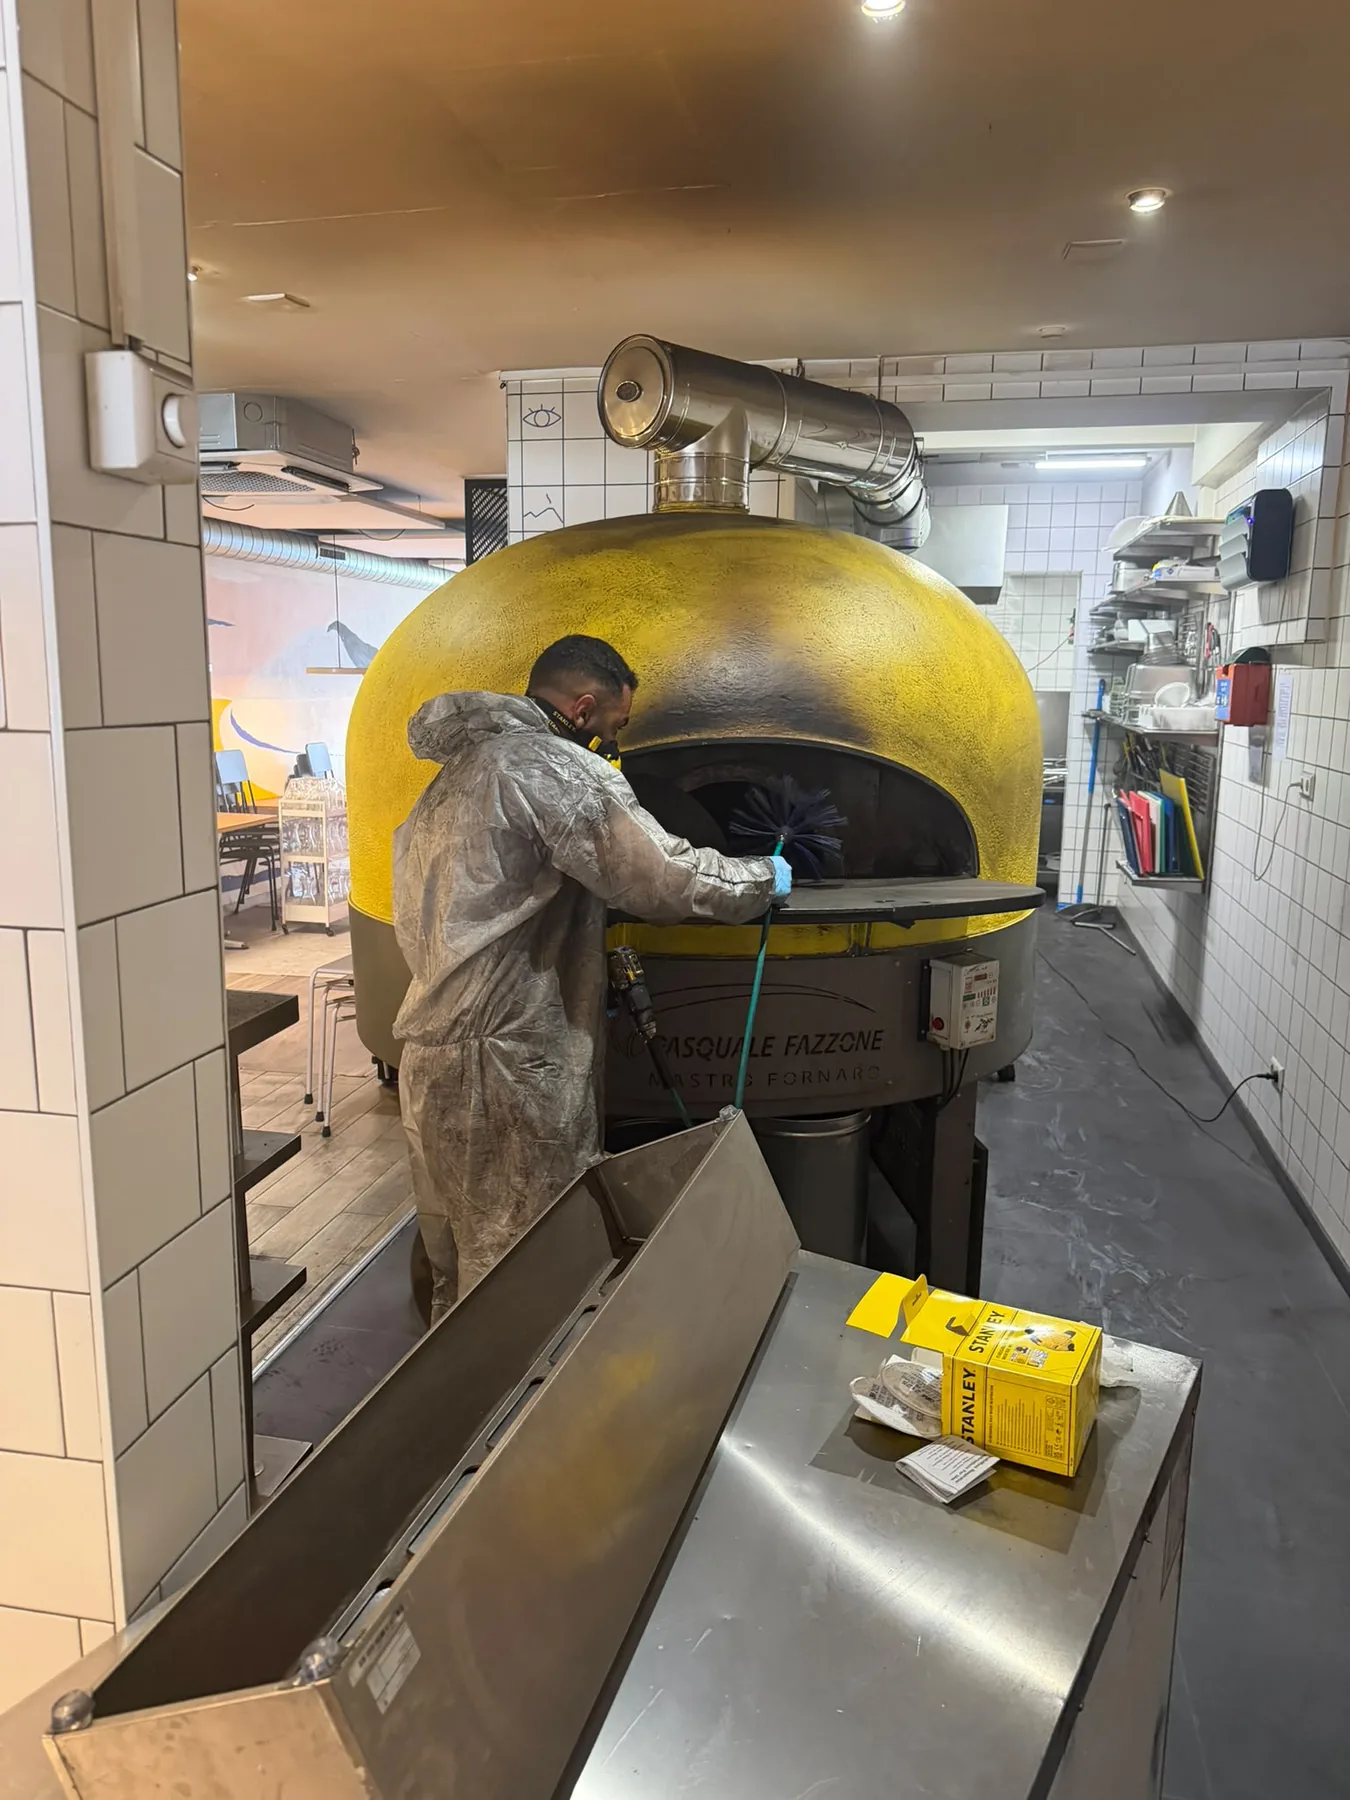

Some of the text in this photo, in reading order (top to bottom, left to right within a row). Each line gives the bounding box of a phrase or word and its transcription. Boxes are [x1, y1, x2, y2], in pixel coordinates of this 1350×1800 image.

[552, 711, 576, 733] STANLEY
[784, 1029, 884, 1056] FAZZONE
[767, 1066, 880, 1087] FORNARO
[961, 1368, 976, 1445] STANLEY
